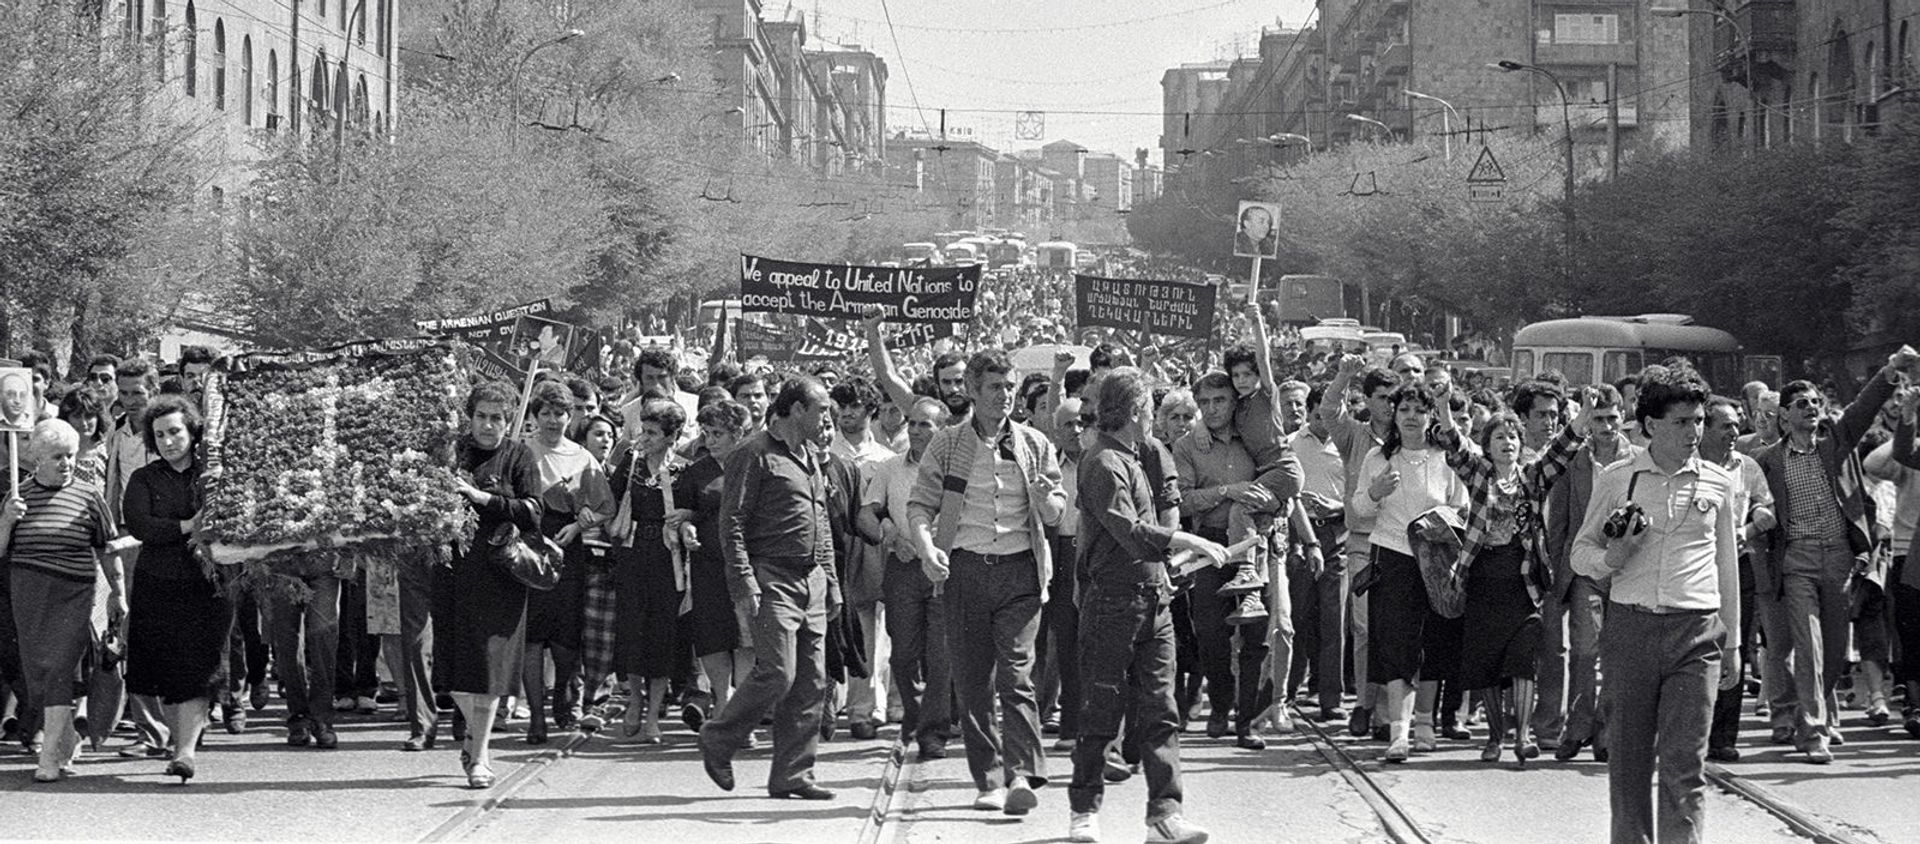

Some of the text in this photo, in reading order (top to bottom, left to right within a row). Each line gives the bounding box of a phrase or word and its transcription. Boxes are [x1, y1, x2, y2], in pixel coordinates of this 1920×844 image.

[741, 255, 974, 294] We appeal to United Nations to
[742, 290, 971, 319] accept the Arman Genocide
[416, 320, 438, 330] THE
[441, 314, 492, 330] ARMENIAN
[468, 329, 492, 339] NOT
